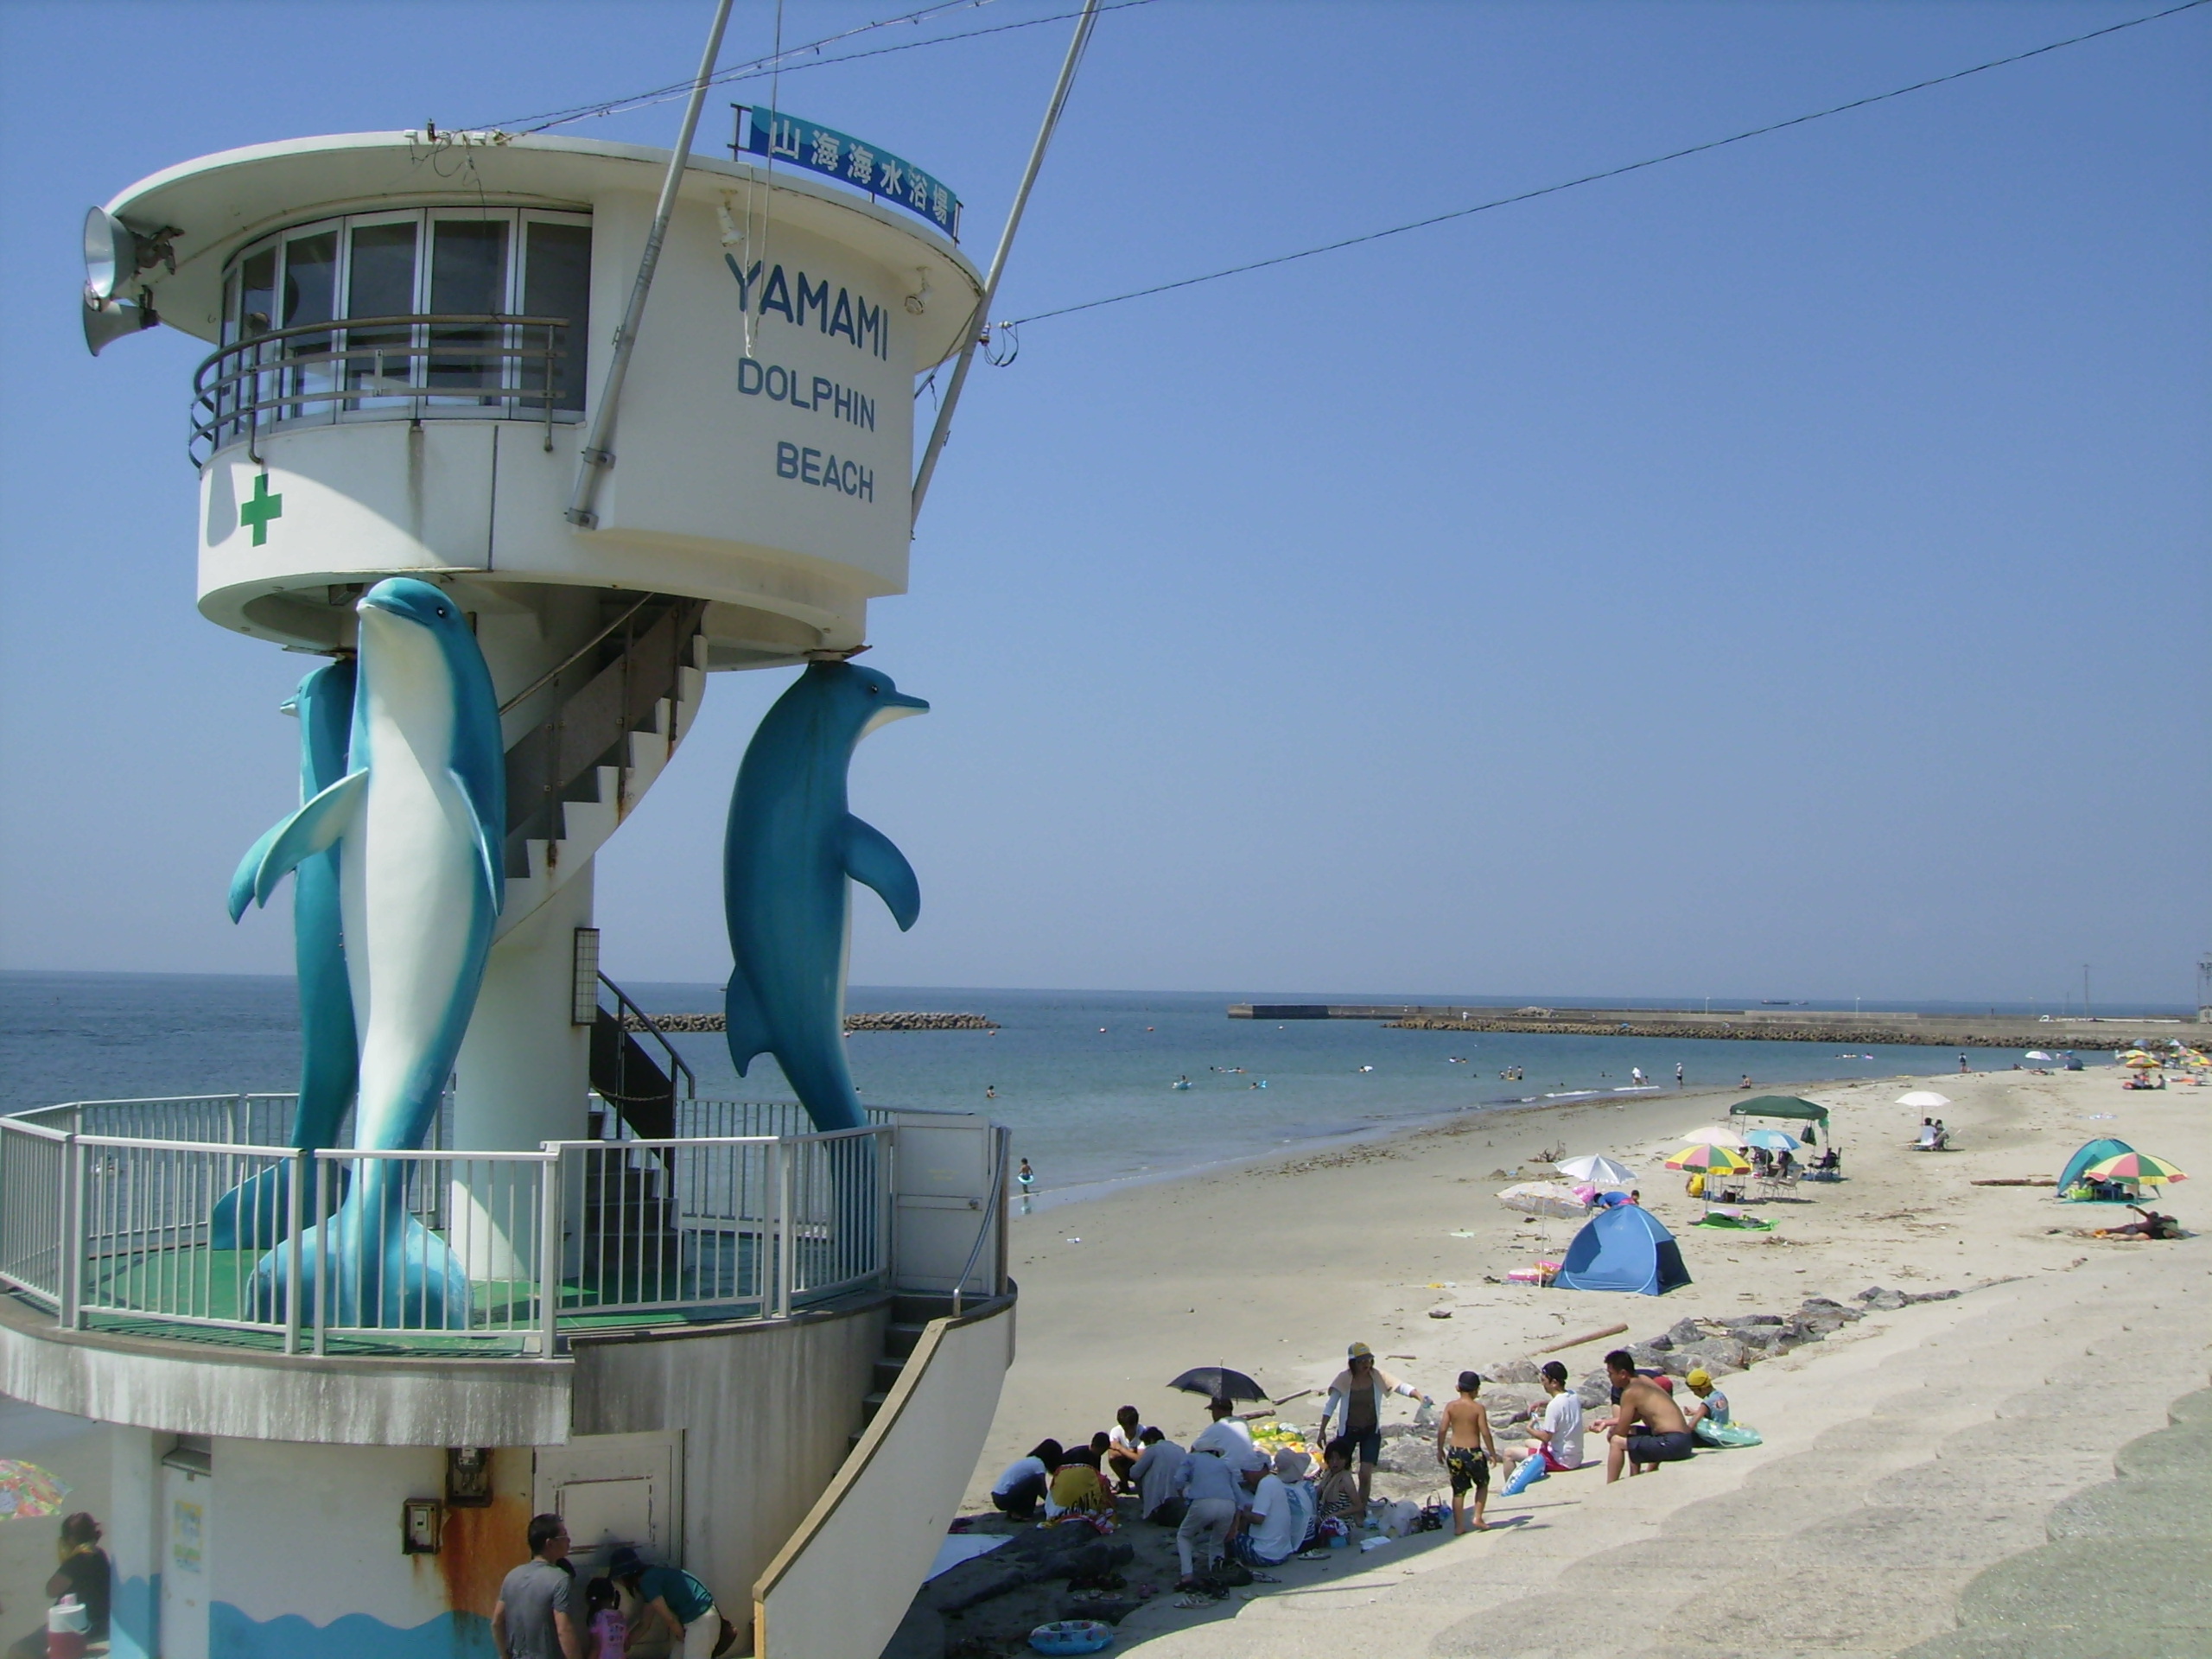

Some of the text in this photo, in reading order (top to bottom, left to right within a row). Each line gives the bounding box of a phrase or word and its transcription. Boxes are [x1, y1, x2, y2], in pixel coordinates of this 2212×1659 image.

[771, 119, 948, 226] 山海海水浴場
[724, 252, 888, 361] YAMAMI
[737, 357, 874, 432] DOLPHIN
[777, 441, 874, 503] BEACH
